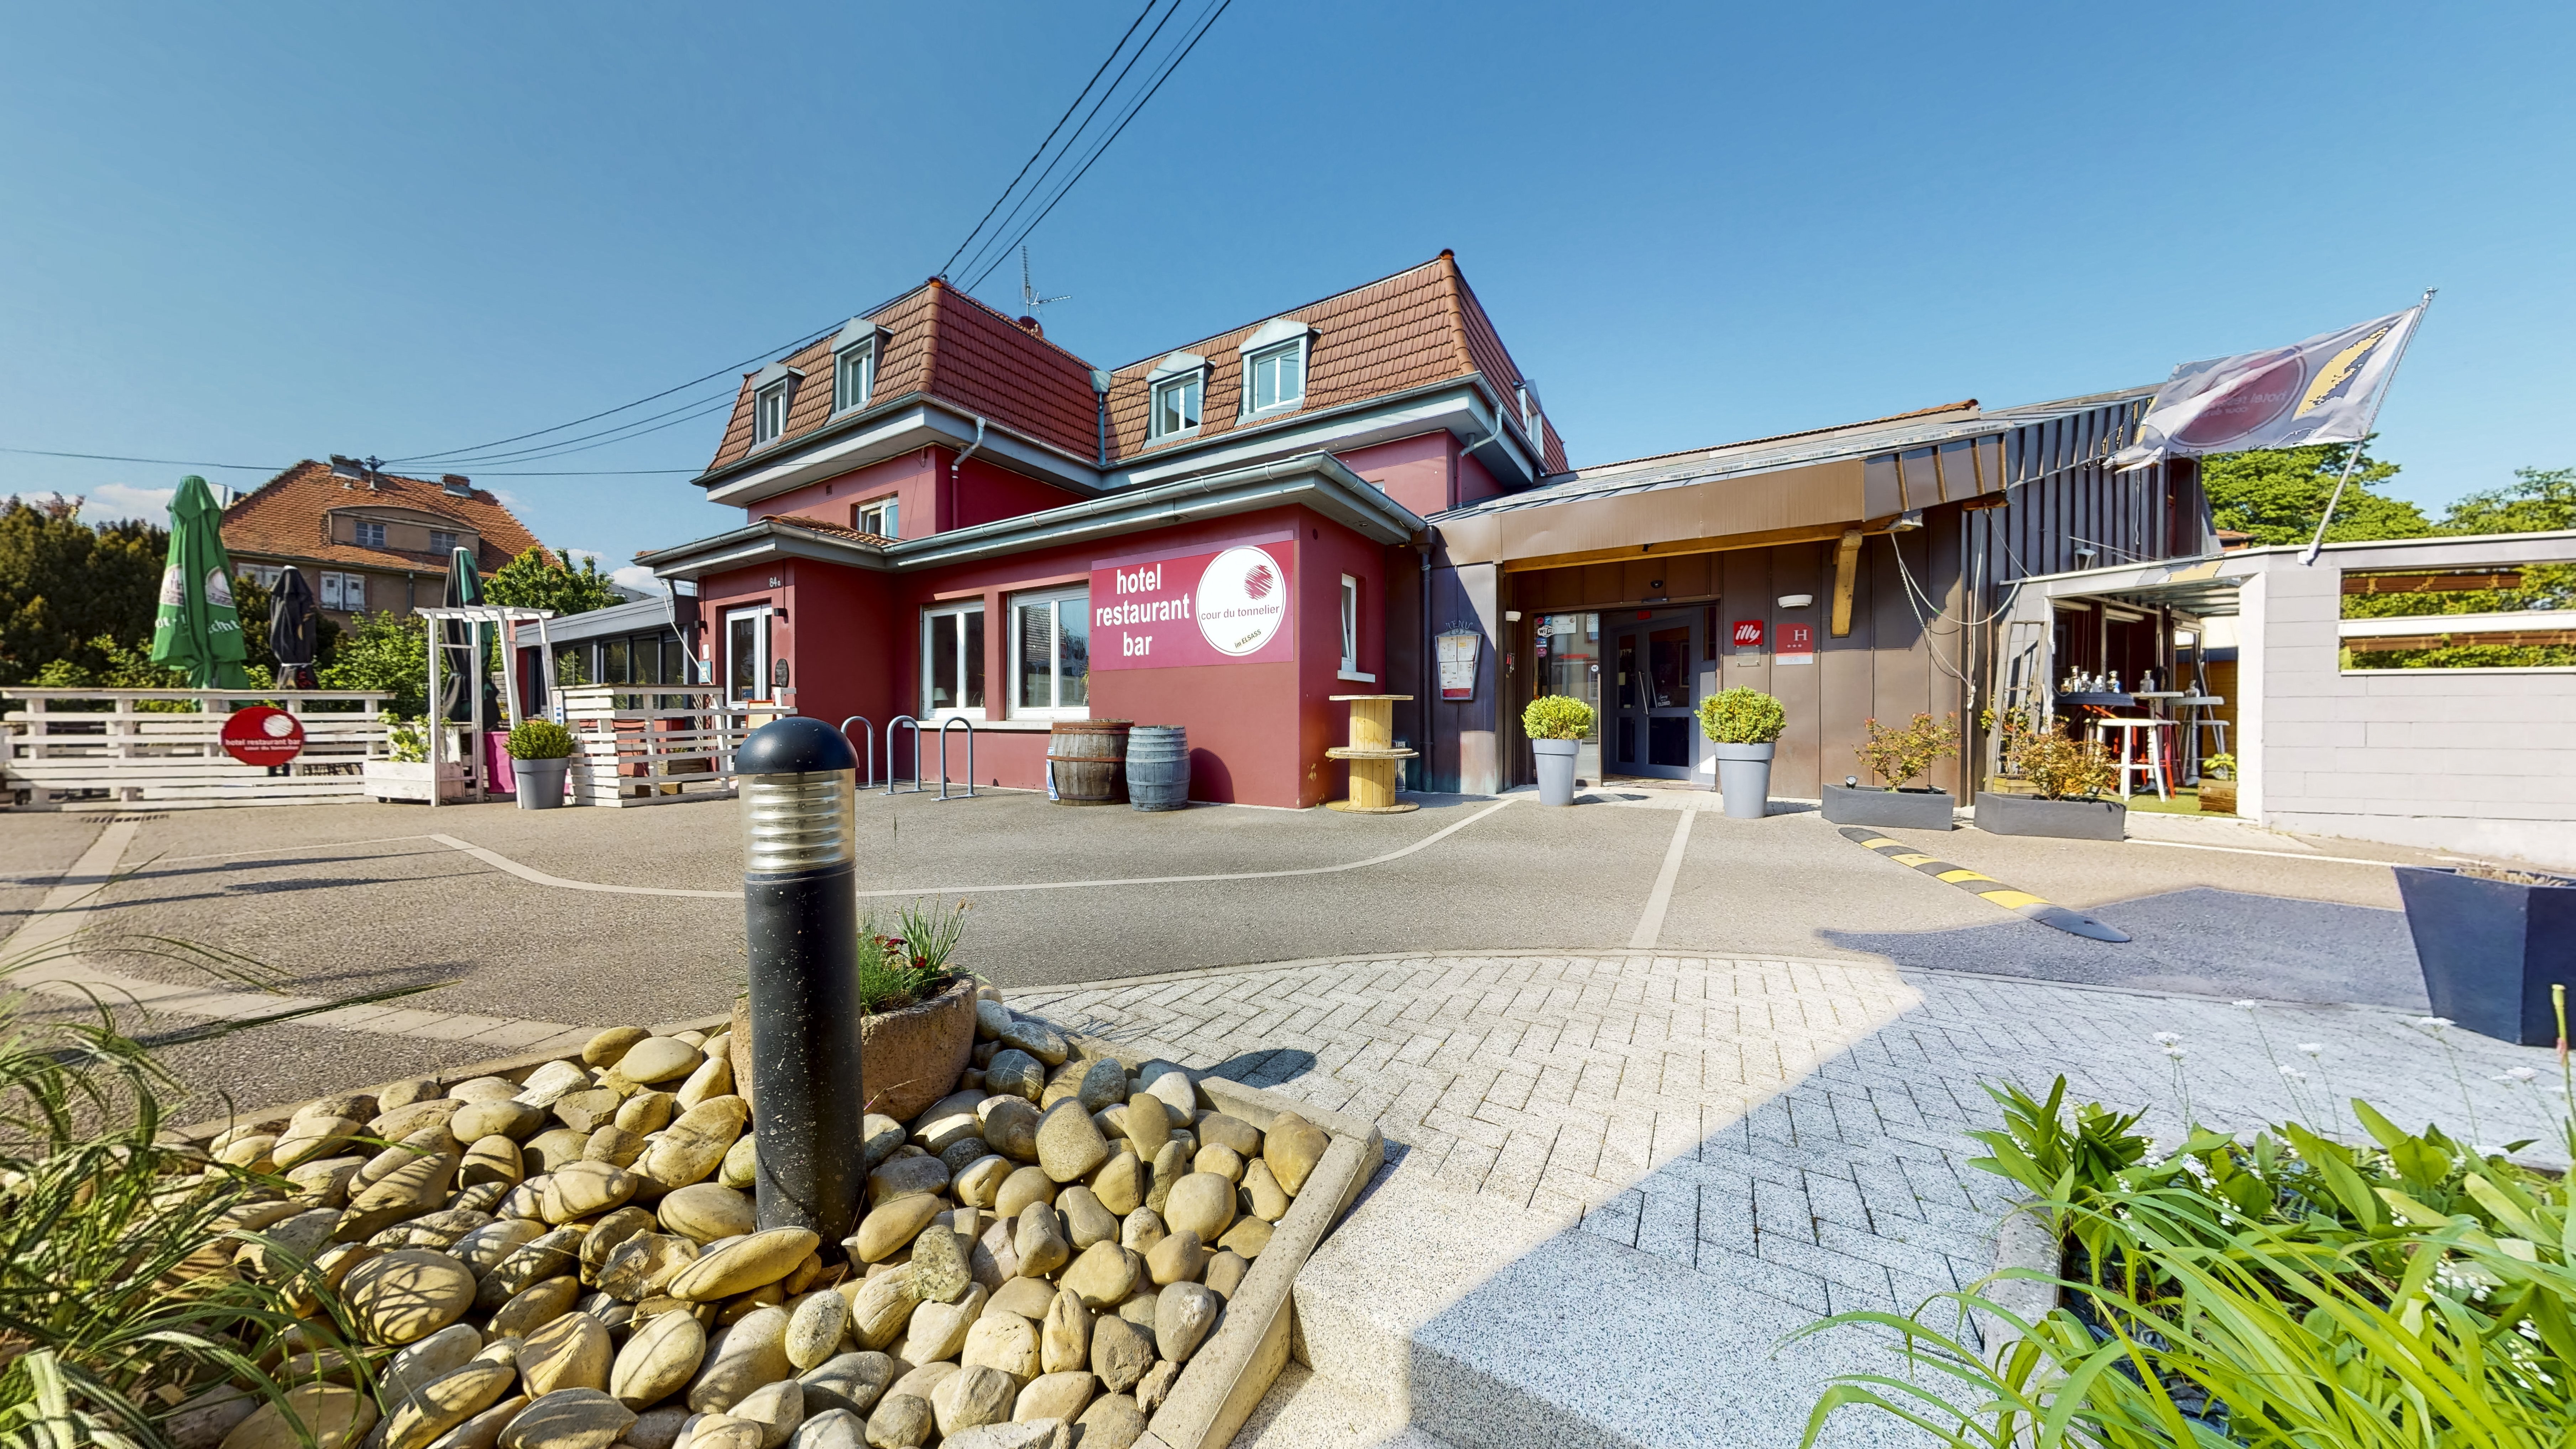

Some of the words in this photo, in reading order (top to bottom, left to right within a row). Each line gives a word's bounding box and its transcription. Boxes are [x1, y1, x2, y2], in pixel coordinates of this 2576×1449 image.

[1117, 563, 1161, 595] hotel
[1096, 592, 1190, 627] restaurant
[1201, 610, 1221, 620] cour
[1223, 609, 1235, 618] du
[1237, 605, 1280, 617] tonnelier
[1242, 629, 1261, 644] ELSASS
[1736, 624, 1760, 643] illy
[1794, 629, 1807, 641] H
[1123, 631, 1153, 657] bar
